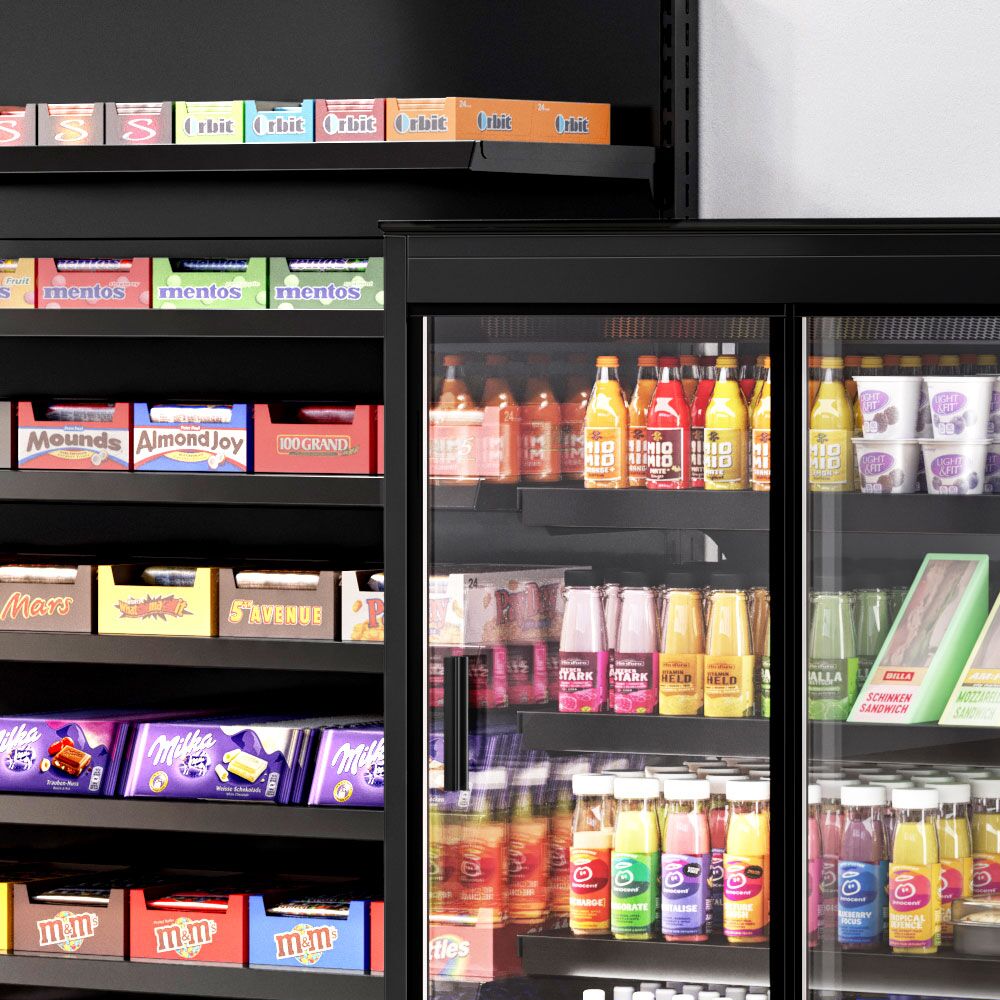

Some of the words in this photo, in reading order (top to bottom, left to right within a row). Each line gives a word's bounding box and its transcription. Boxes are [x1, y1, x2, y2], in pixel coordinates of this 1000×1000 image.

[184, 116, 234, 136] Orbit
[253, 115, 305, 136] Orbit
[323, 113, 377, 134] Orbit
[395, 113, 448, 134] Orbit
[477, 111, 512, 131] Orbit
[555, 114, 589, 134] Orbit
[6, 277, 30, 286] Fruit
[44, 283, 126, 300] mentos
[159, 283, 242, 300] mentos
[275, 283, 361, 300] mentos
[27, 431, 122, 452] Mounds
[136, 430, 210, 454] Almond
[212, 431, 243, 455] Joy
[279, 438, 300, 451] 100
[301, 438, 349, 451] GRAND
[468, 578, 479, 589] 24
[0, 592, 74, 621] Mars
[250, 603, 323, 626] AVENUE
[661, 675, 692, 683] HELD
[707, 676, 737, 685] HELD
[885, 672, 912, 681] BILLA
[866, 692, 912, 703] SCHINKEN
[859, 703, 910, 714] SANDWICH
[0, 723, 42, 753] ilka
[147, 729, 217, 766] Milka
[332, 738, 384, 775] Milk
